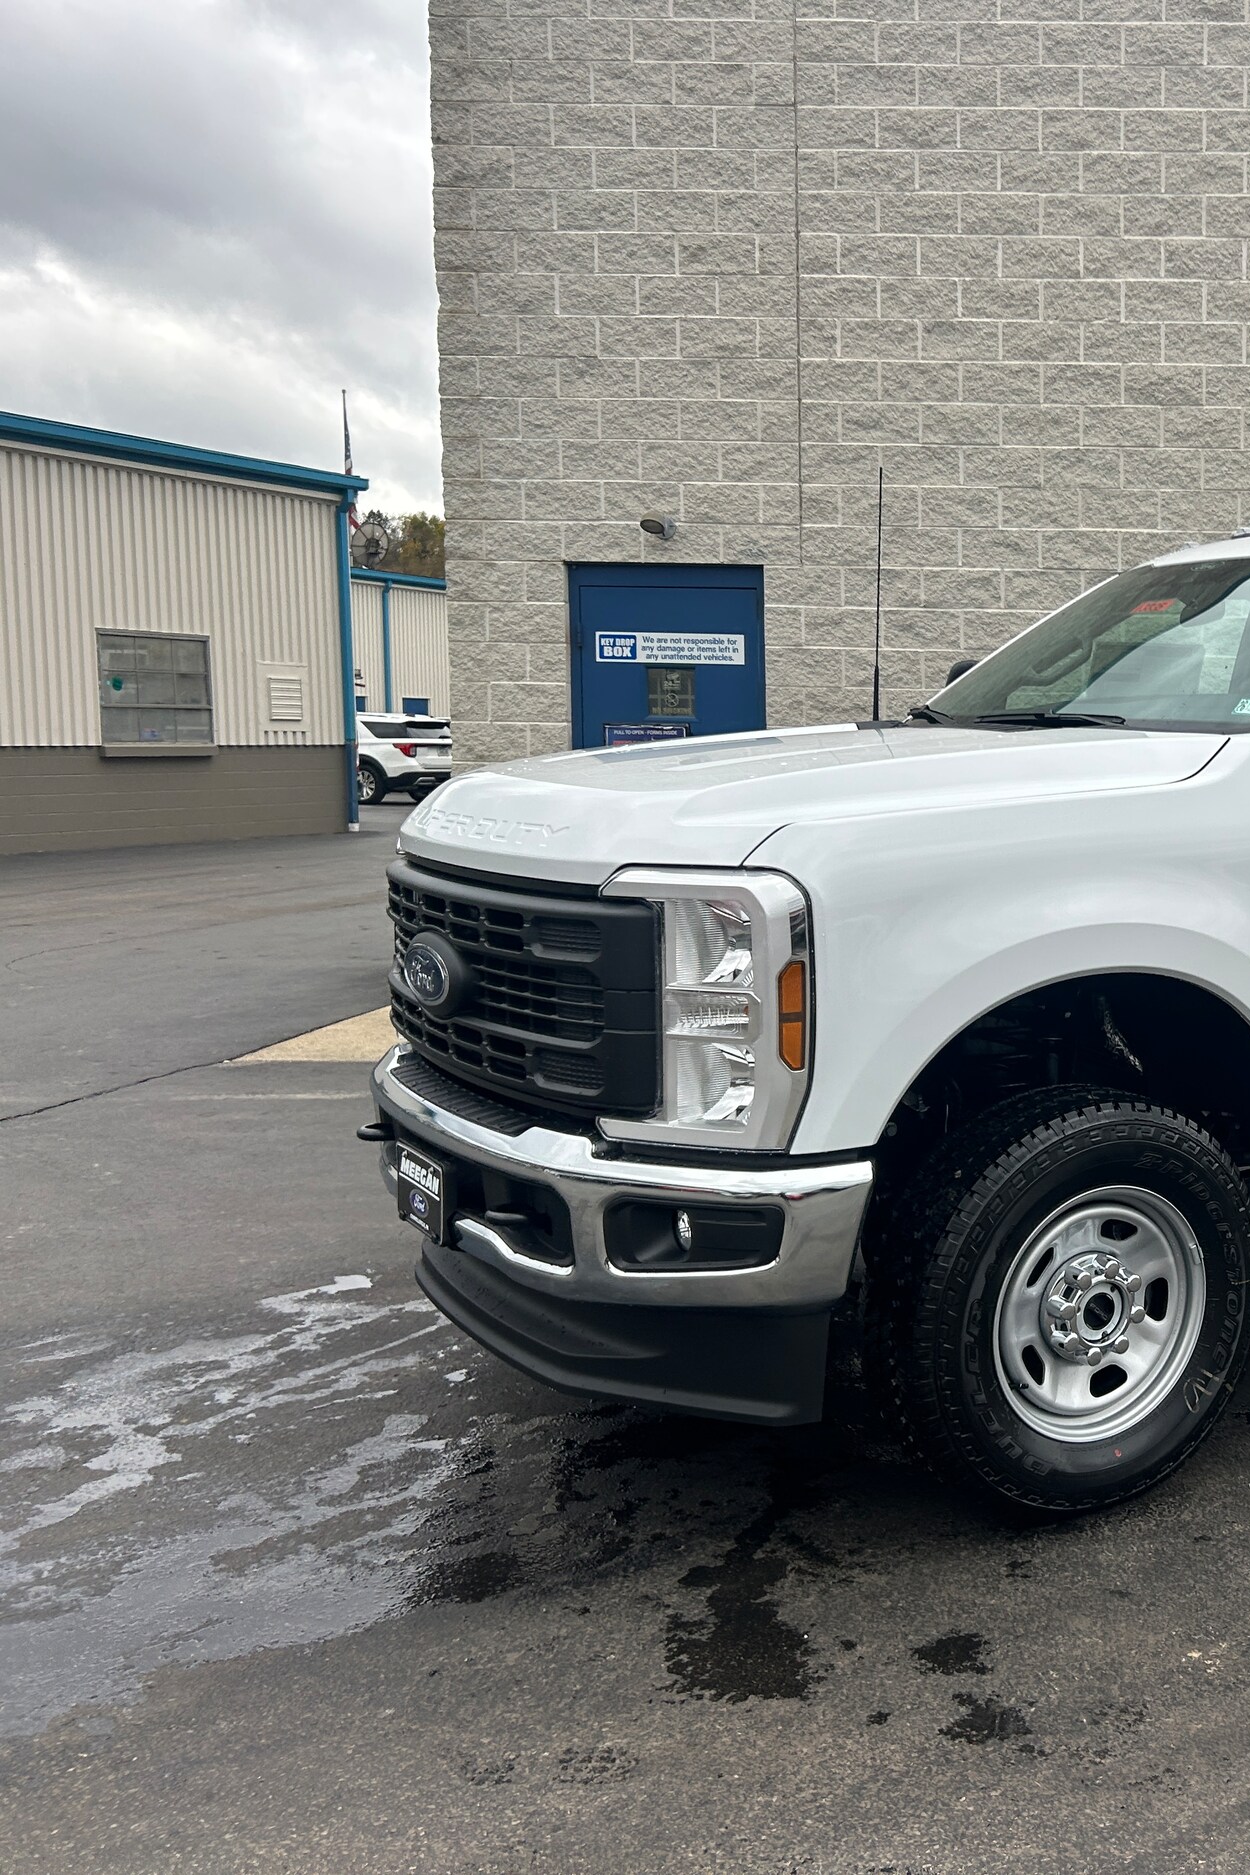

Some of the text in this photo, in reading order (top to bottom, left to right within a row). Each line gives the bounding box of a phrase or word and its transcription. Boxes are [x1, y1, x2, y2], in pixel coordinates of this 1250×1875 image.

[601, 637, 635, 647] KEY DROP
[642, 636, 655, 644] We
[683, 637, 725, 646] responsible
[727, 637, 737, 645] for
[604, 646, 632, 657] BOX
[641, 645, 654, 653] any
[656, 645, 685, 654] damage
[697, 645, 716, 653] items
[718, 645, 731, 653] left
[646, 653, 735, 662] any unattended vehicles.
[468, 816, 571, 848] DUTY
[410, 954, 436, 992] Ford
[400, 1156, 440, 1195] MEEGAN
